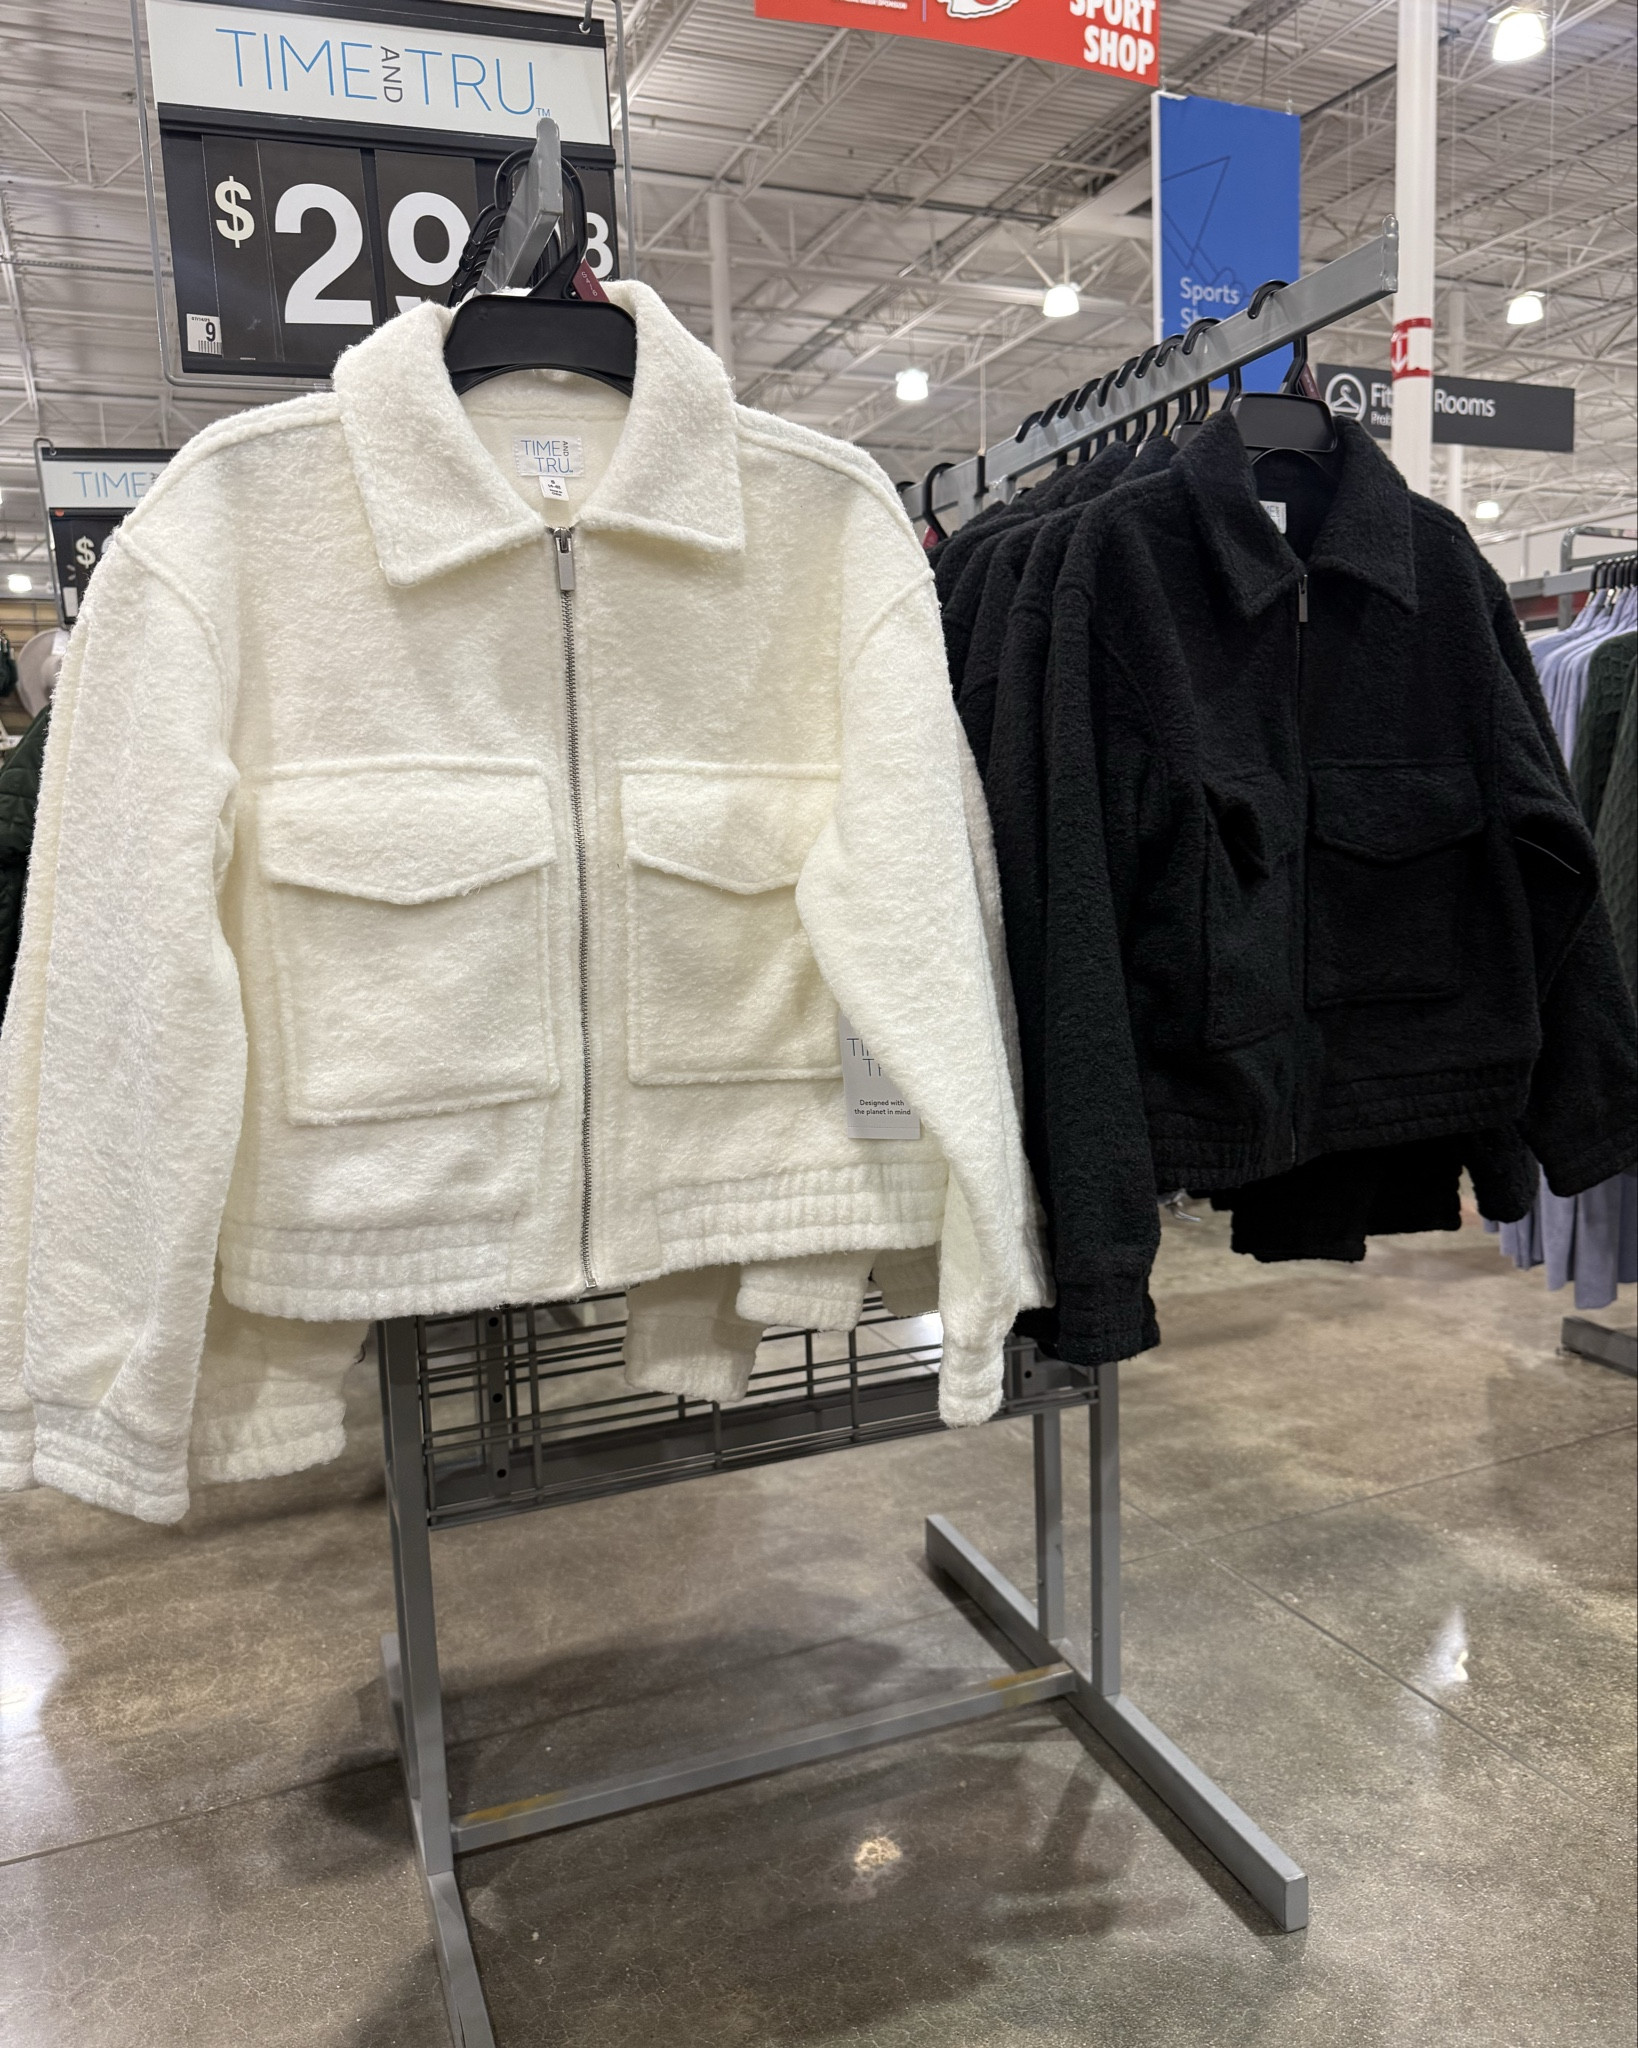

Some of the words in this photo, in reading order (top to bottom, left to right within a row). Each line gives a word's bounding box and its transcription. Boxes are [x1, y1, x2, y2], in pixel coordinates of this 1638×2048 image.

[1083, 24, 1156, 76] SHOP
[215, 28, 378, 101] TIME
[380, 45, 404, 104] AND
[404, 48, 535, 115] TRU
[1180, 277, 1241, 306] Sports
[205, 321, 216, 342] 9
[1435, 388, 1497, 418] Rooms
[520, 439, 562, 457] TIME
[562, 440, 570, 457] AND
[534, 457, 570, 474] TRU
[72, 471, 147, 498] TIME
[75, 535, 96, 569] $
[859, 1099, 889, 1107] Designed
[866, 1108, 886, 1116] planet
